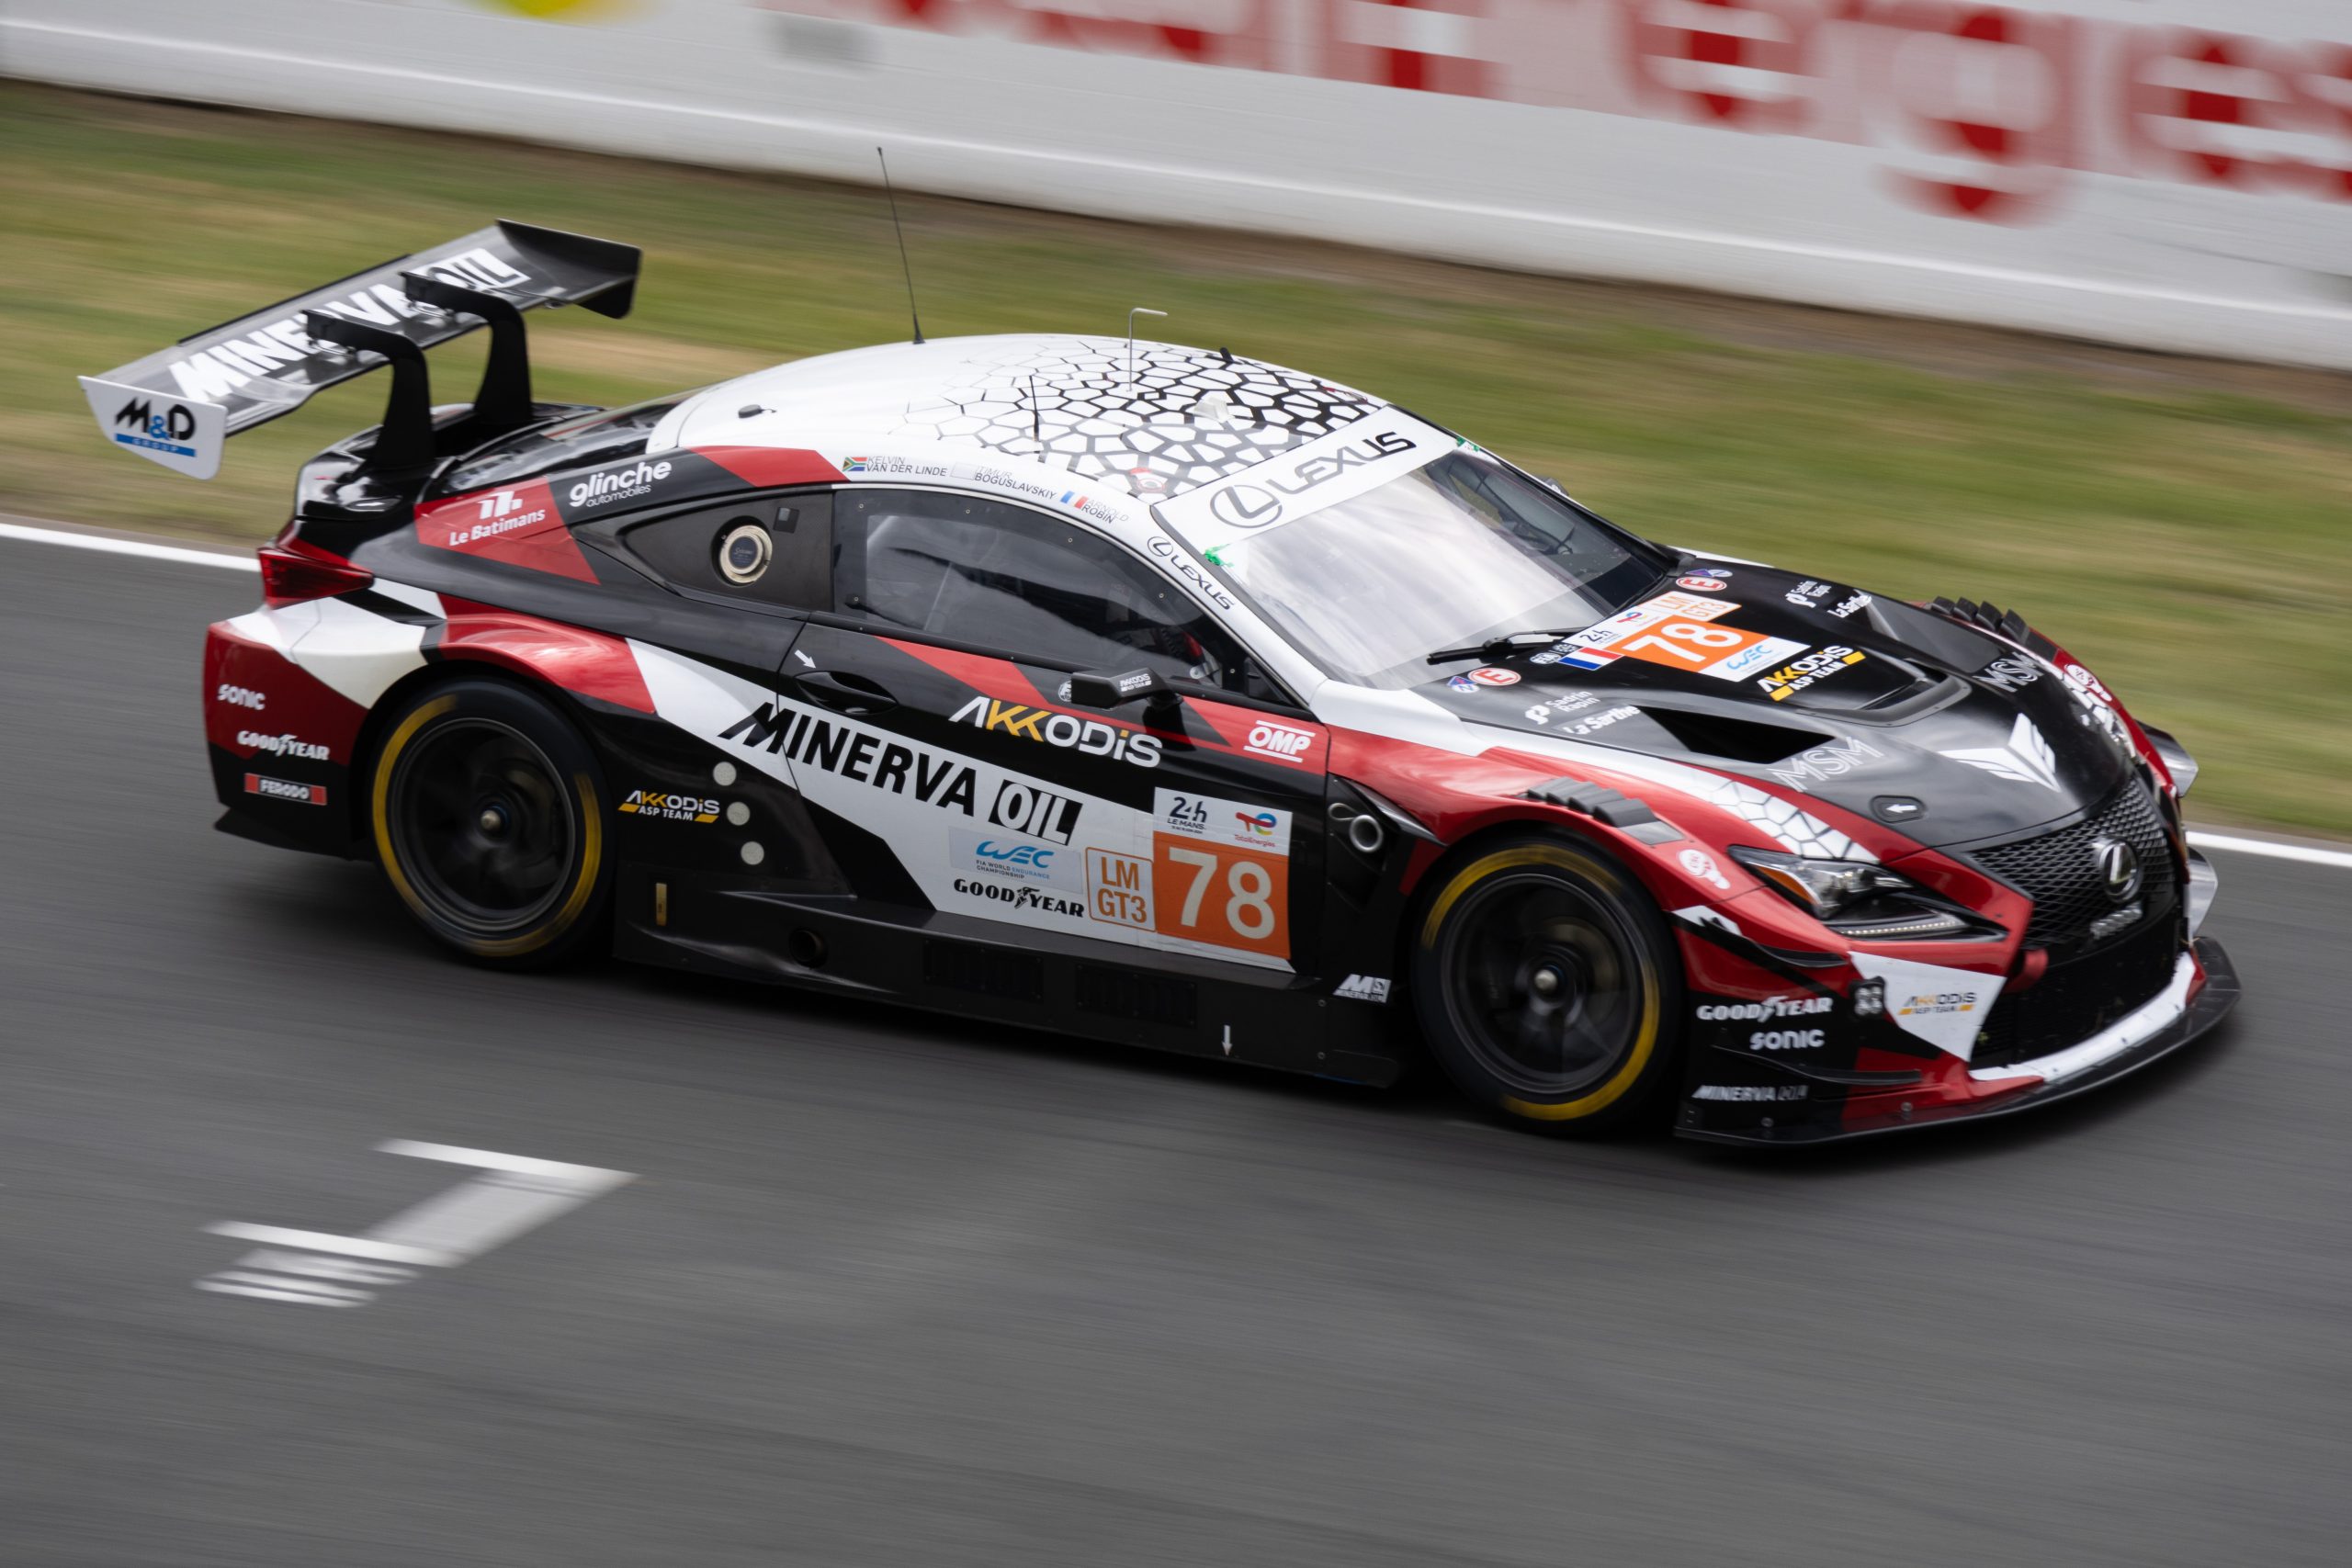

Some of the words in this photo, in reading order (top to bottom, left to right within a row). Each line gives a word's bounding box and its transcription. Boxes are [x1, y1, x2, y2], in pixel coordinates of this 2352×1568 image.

[114, 396, 196, 441] M&D
[866, 463, 888, 472] VAN
[890, 464, 912, 474] DER
[915, 466, 948, 477] LINDE
[867, 456, 906, 465] KELVIN
[1265, 431, 1418, 495] LEXUS
[570, 461, 673, 507] glinche
[585, 484, 651, 508] automobiles
[975, 472, 1057, 500] BOGUSLAVSKIY
[449, 529, 468, 546] Le
[470, 509, 546, 541] Batimans
[1081, 503, 1115, 525] ROBIN
[1170, 555, 1234, 610] LEXUS
[1622, 623, 1743, 662] 78
[1726, 645, 1773, 670] WEC
[1789, 675, 1815, 691] ASP
[1815, 661, 1849, 679] TEAM
[1558, 696, 1601, 713] Rapin
[1563, 722, 1591, 735] La
[1584, 705, 1641, 729] Sarthe
[1248, 725, 1312, 756] OMP
[717, 701, 977, 818] MINERVA
[995, 783, 1074, 846] OIL
[639, 806, 660, 817] ASP
[662, 808, 694, 821] TEAM
[1170, 796, 1207, 823] 24h
[1179, 819, 1204, 829] MANS
[976, 840, 1054, 868] WEC
[988, 862, 1011, 871] WORLD
[977, 865, 1025, 879] CHAMPIONSHIP
[1101, 856, 1140, 891] LM
[1097, 888, 1148, 923] GT3
[1169, 846, 1275, 940] 78
